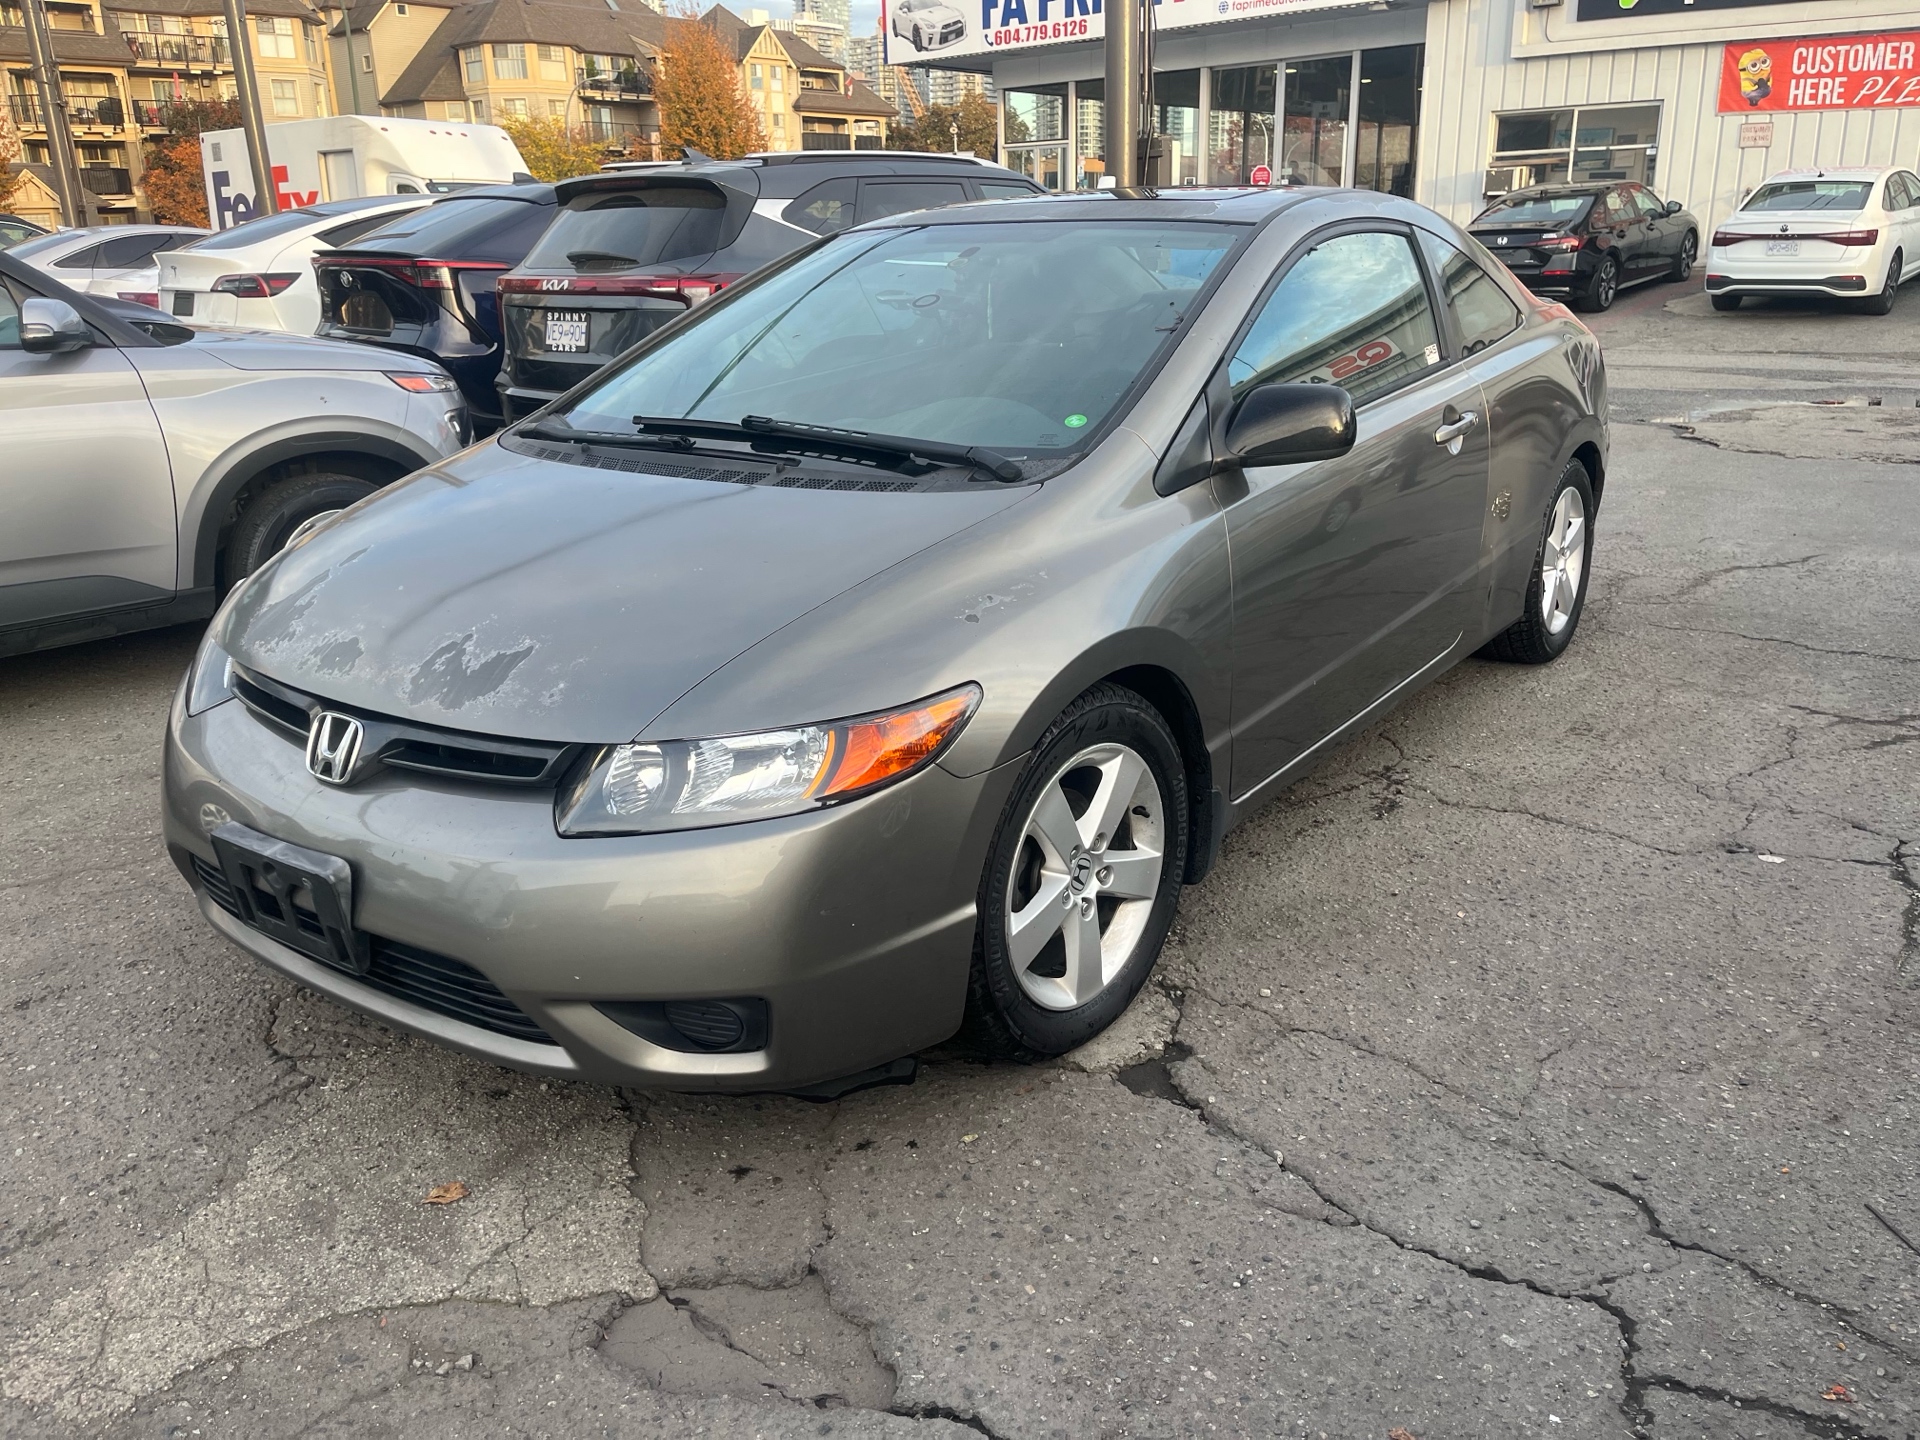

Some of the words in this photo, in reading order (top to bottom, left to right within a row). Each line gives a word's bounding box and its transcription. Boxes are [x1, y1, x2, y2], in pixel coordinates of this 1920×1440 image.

[994, 19, 1088, 46] 604.779.6126
[1791, 41, 1915, 75] CUSTOMER
[1788, 76, 1848, 106] HERE
[1852, 75, 1920, 104] PLE
[212, 166, 319, 231] FeEx
[547, 312, 586, 321] SPINNY
[552, 343, 576, 352] CARS
